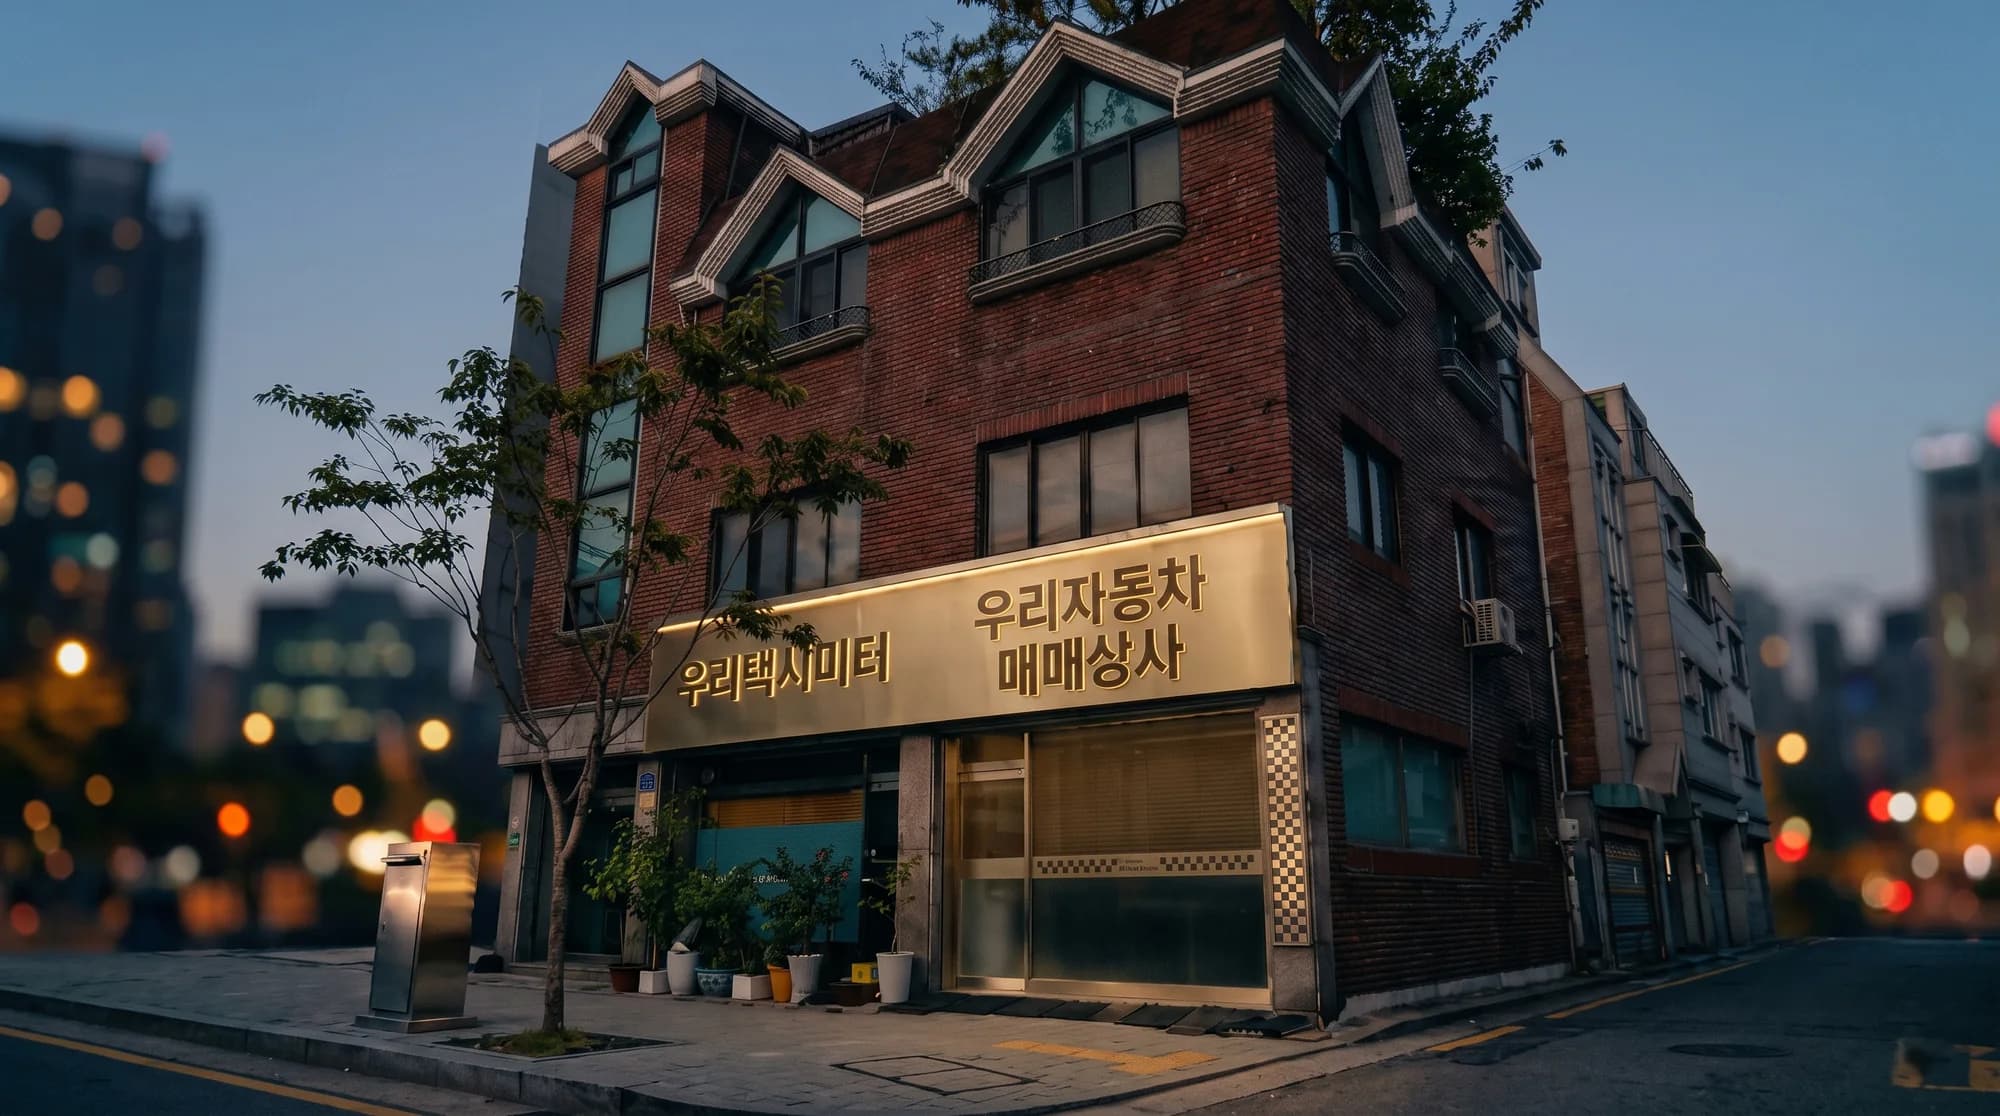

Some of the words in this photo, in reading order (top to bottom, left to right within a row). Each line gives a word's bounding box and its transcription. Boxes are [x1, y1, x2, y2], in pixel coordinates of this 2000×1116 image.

[974, 554, 1207, 640] 우리자동차
[677, 631, 890, 707] 우리택시미터
[998, 623, 1186, 697] 매매상사
